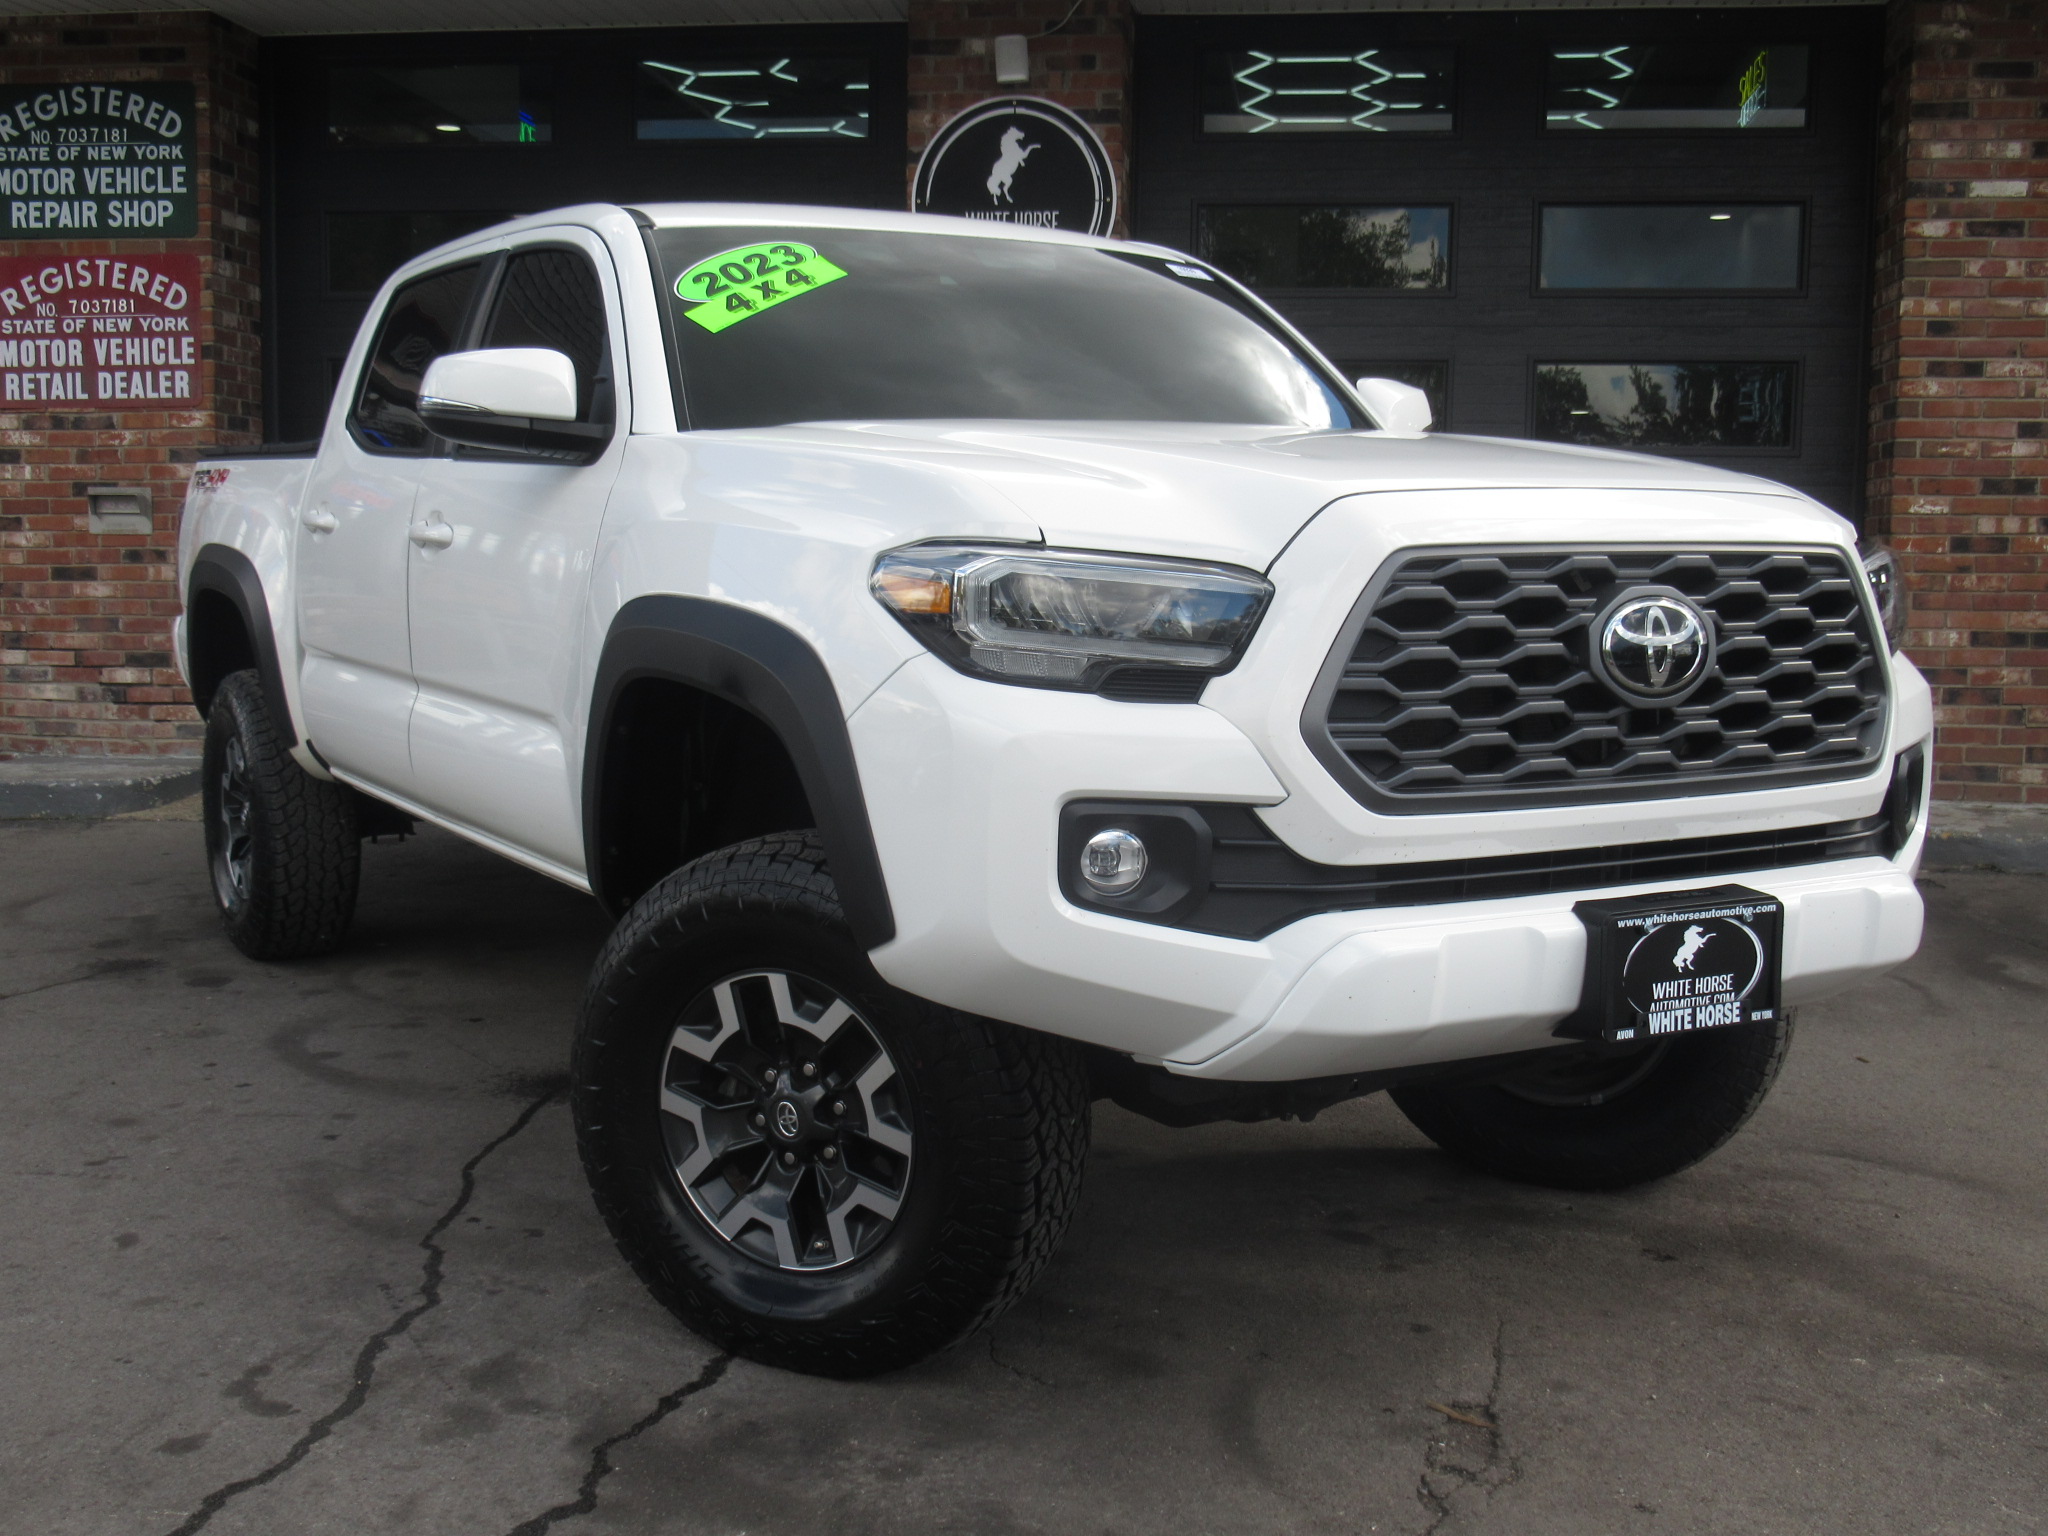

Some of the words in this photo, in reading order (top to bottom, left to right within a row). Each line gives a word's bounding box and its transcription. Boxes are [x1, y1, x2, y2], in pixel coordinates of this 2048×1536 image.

[0, 86, 182, 143] REGISTERED
[31, 131, 53, 145] NO.
[58, 128, 129, 143] 7037181
[0, 147, 50, 162] STATE
[57, 147, 81, 162] OF
[87, 146, 127, 161] NEW
[134, 144, 184, 161] YORK
[83, 166, 188, 195] VEHICLE
[11, 201, 98, 229] REPAIR
[107, 199, 174, 228] SHOP
[692, 245, 807, 298] 2023
[0, 259, 188, 316] REGISTERED
[36, 302, 58, 317] NO.
[69, 298, 135, 314] 7037181
[1, 319, 56, 334] STATE
[63, 318, 86, 333] OF
[93, 317, 132, 333] NEW
[139, 316, 189, 332] YORK
[0, 338, 83, 367] MOTOR
[93, 336, 195, 366] VEHICLE
[5, 372, 89, 400] RETAIL
[98, 370, 190, 399] DEALER
[1617, 904, 1777, 928] www.whitehorseautomotive.com
[1652, 979, 1692, 999] WHITE
[1695, 973, 1734, 994] HORSE
[1649, 1009, 1693, 1035] WHITE
[1695, 1002, 1741, 1028] HORSE
[1751, 1011, 1761, 1021] NEW
[1761, 1010, 1773, 1020] YORK
[1616, 1029, 1634, 1041] AVON
